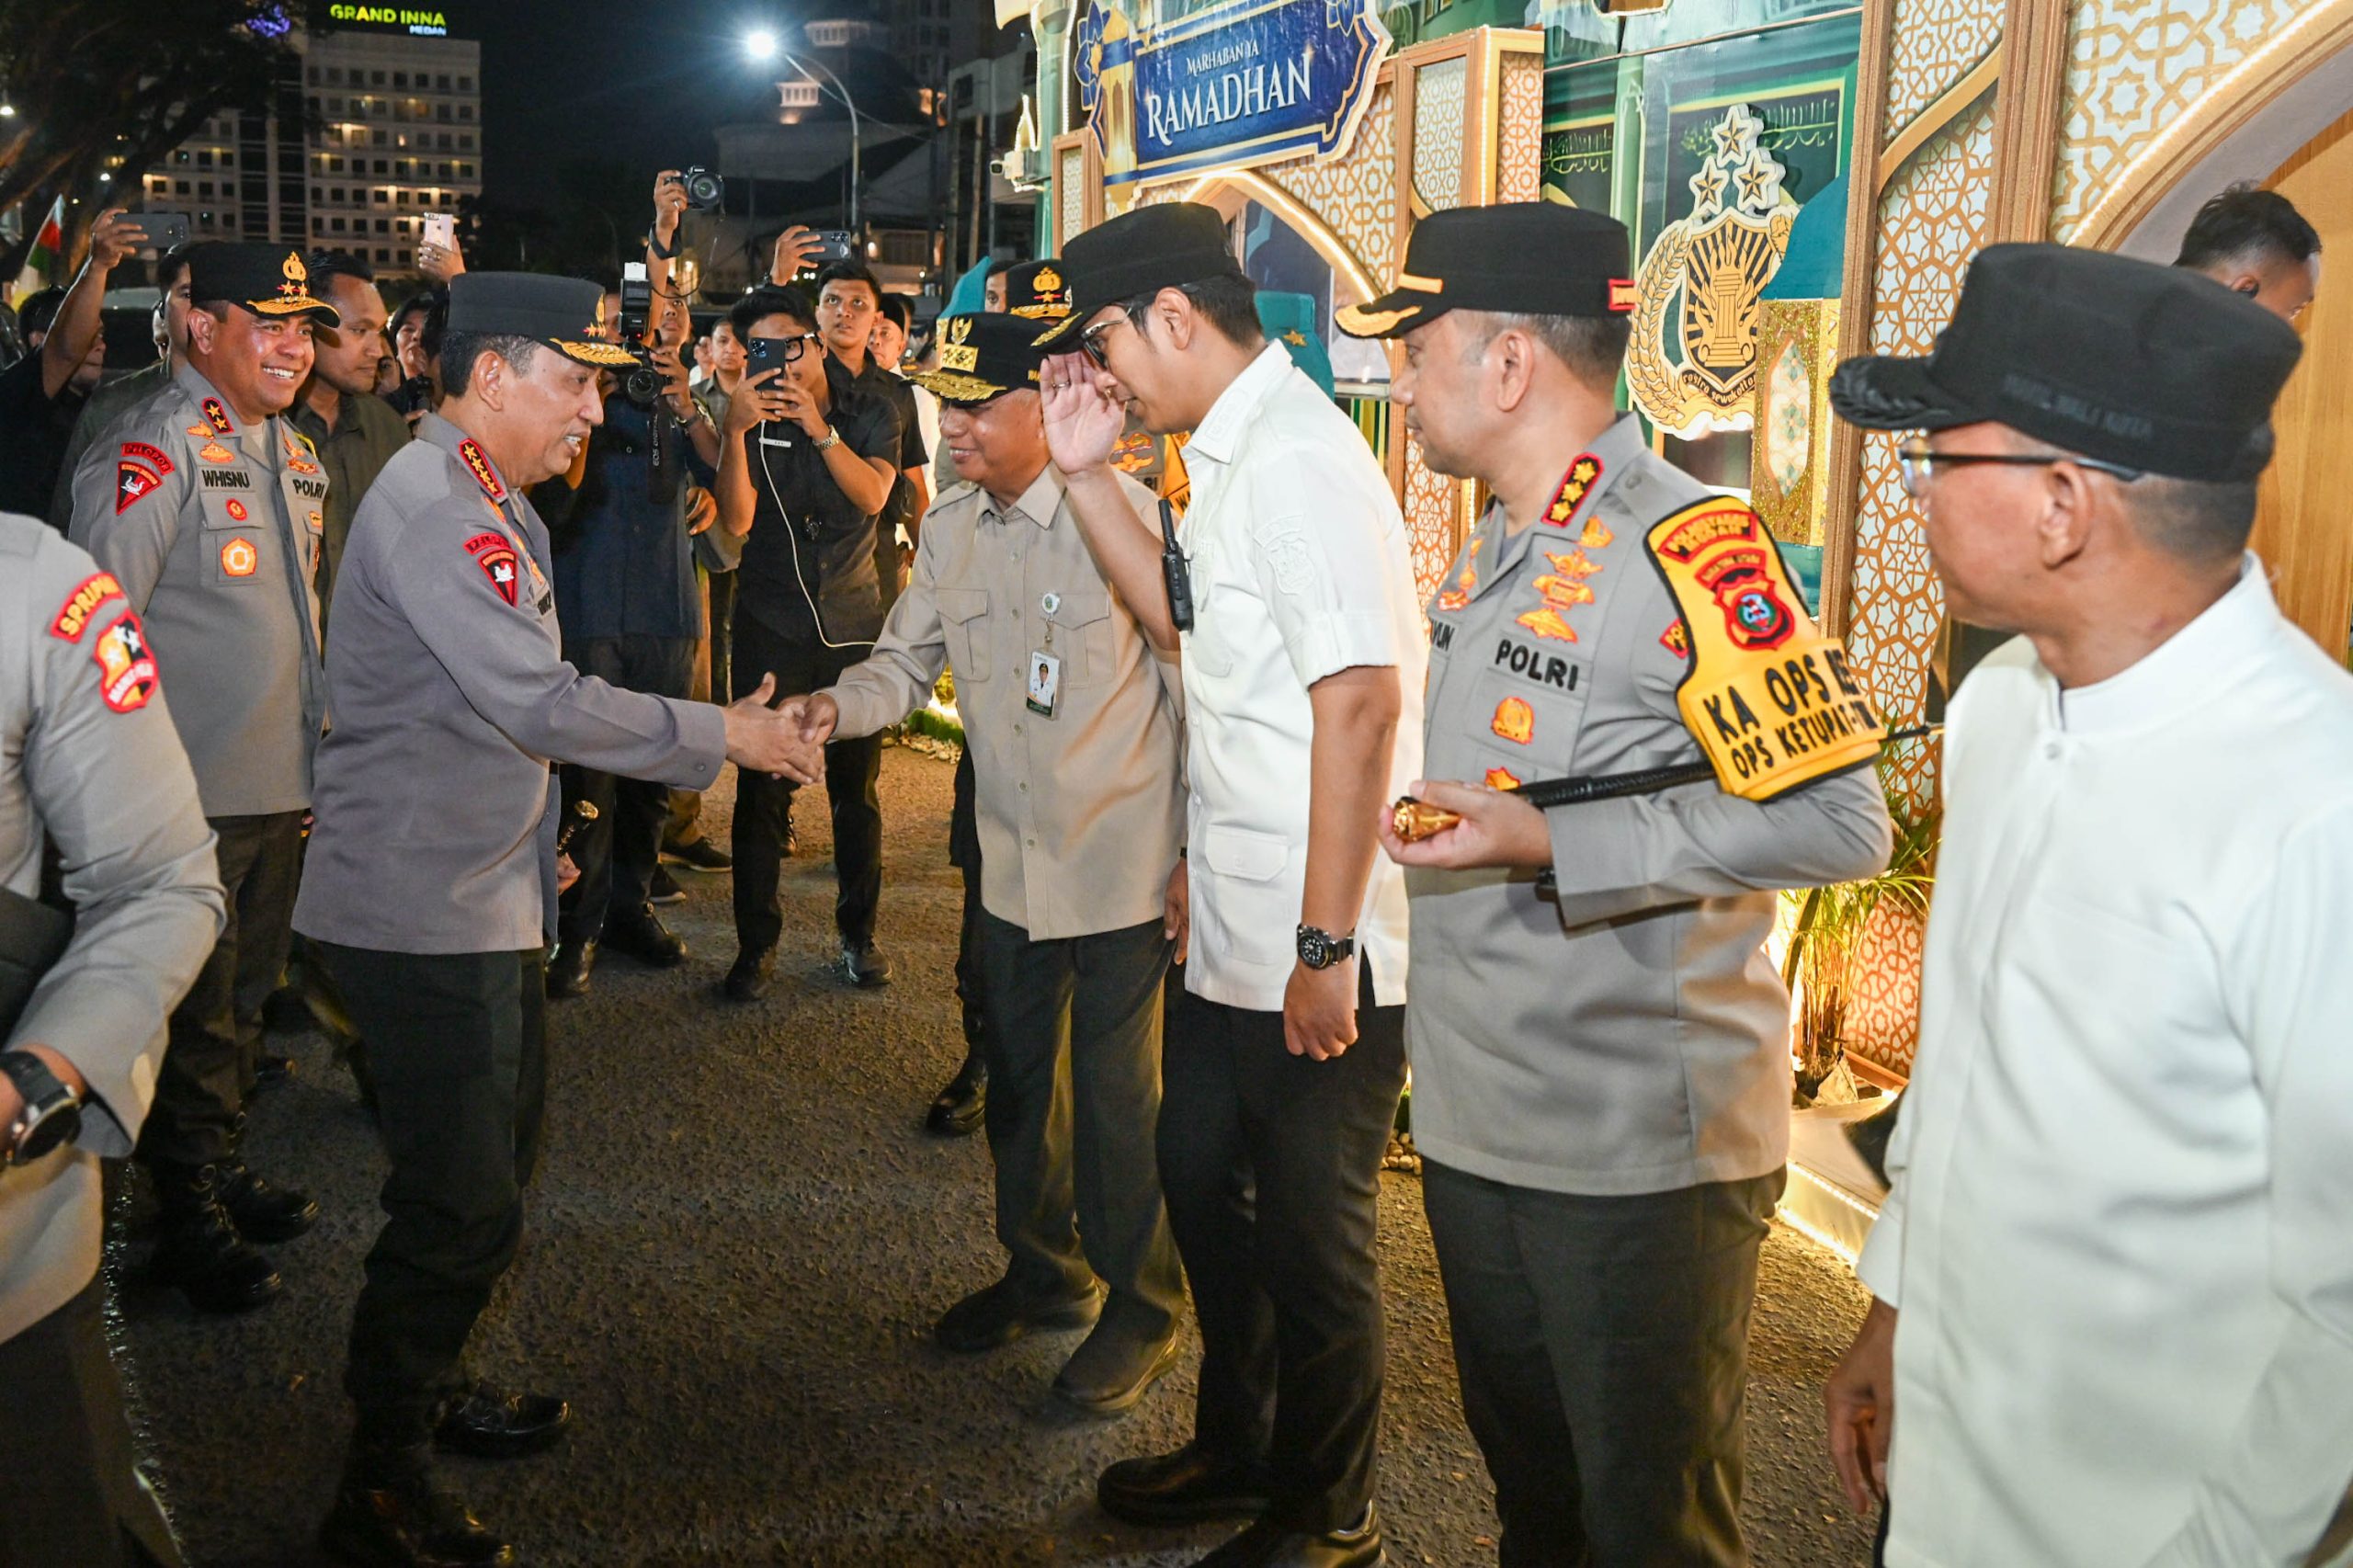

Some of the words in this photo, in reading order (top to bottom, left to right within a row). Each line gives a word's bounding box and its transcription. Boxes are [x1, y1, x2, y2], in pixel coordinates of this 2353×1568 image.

[331, 4, 396, 23] GRAND
[401, 10, 446, 26] INNA
[409, 25, 447, 36] MEDAN
[1245, 39, 1259, 57] YA
[1148, 52, 1312, 146] RAMADHAN
[201, 469, 251, 489] WHISNU
[292, 478, 325, 499] POLRI
[1495, 639, 1579, 691] POLRI
[1703, 686, 1760, 745] KA
[1765, 653, 1831, 717] OPS
[1731, 734, 1774, 779] OPS
